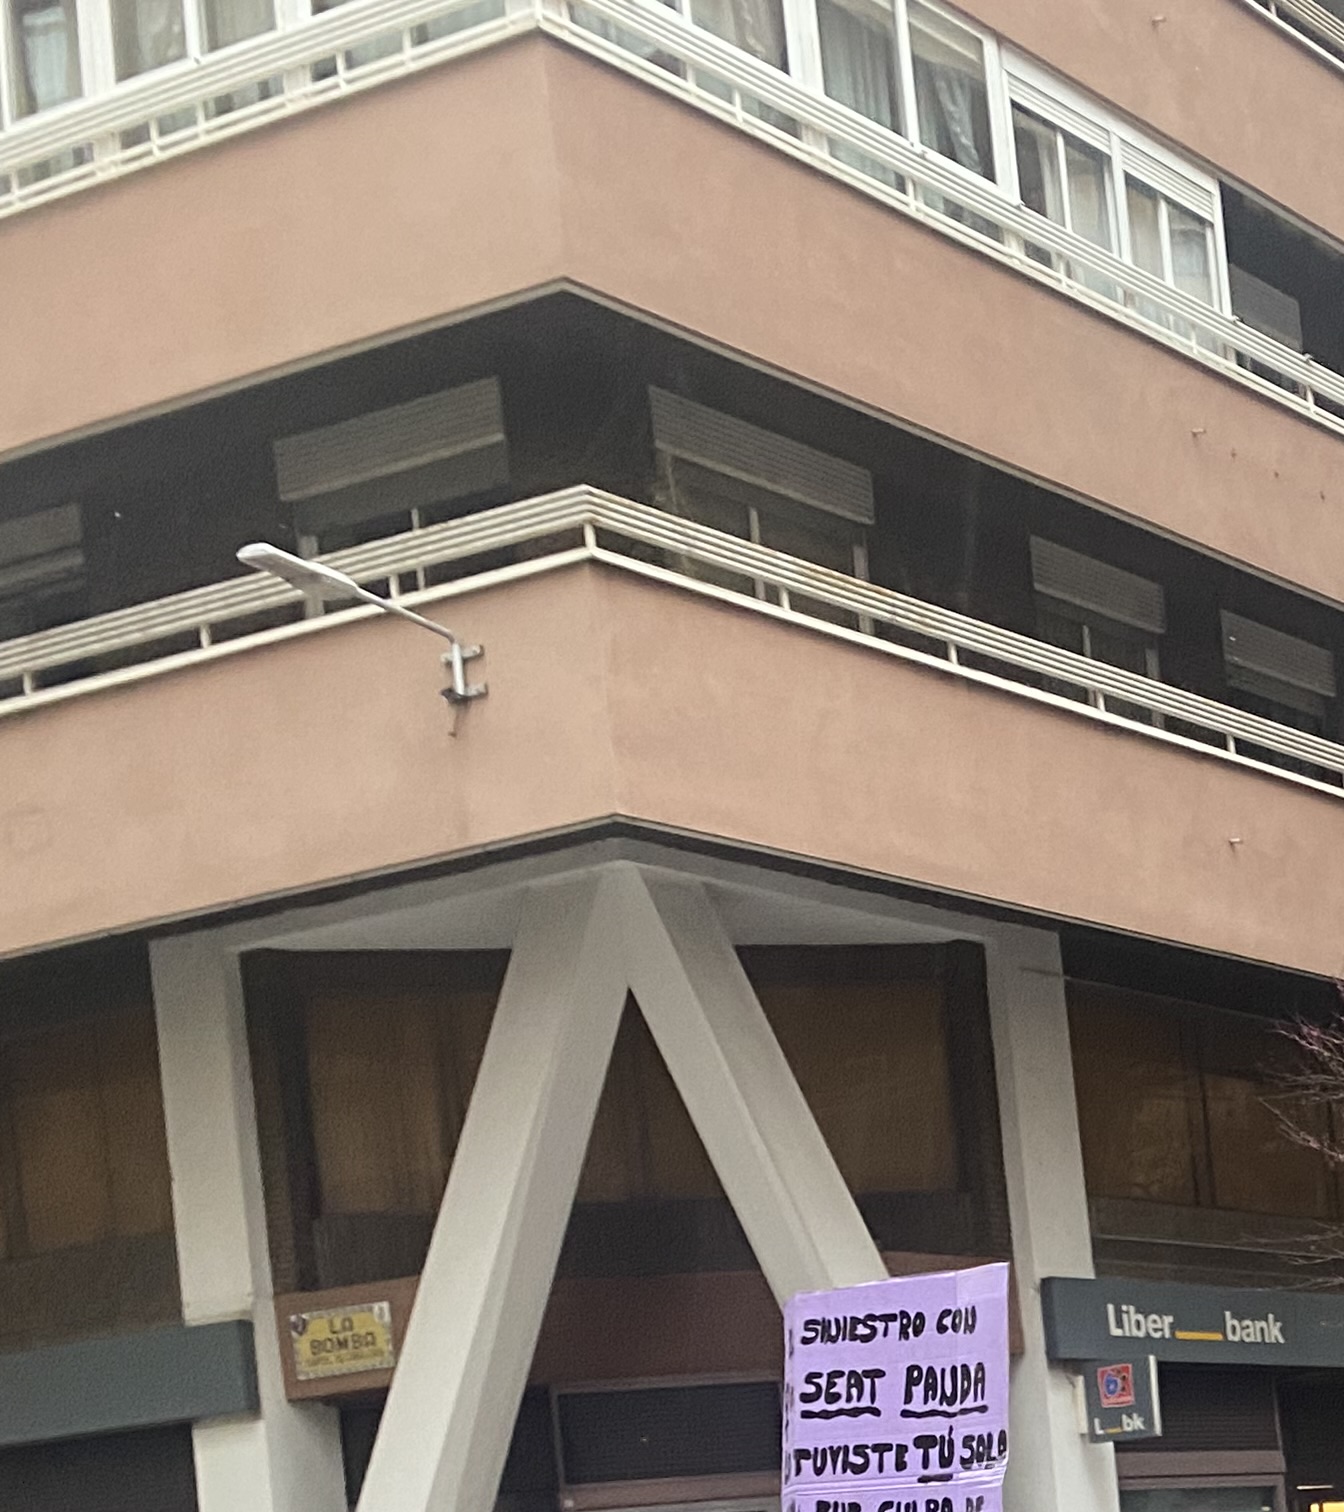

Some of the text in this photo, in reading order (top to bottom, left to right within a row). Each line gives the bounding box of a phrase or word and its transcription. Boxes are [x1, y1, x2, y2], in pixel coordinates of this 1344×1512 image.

[801, 1306, 977, 1345] SINIESTRO CON
[1106, 1303, 1285, 1344] Liber bank
[799, 1362, 985, 1406] SEAT PANDA
[793, 1443, 909, 1476] TUVISTE
[913, 1425, 954, 1470] TÚ
